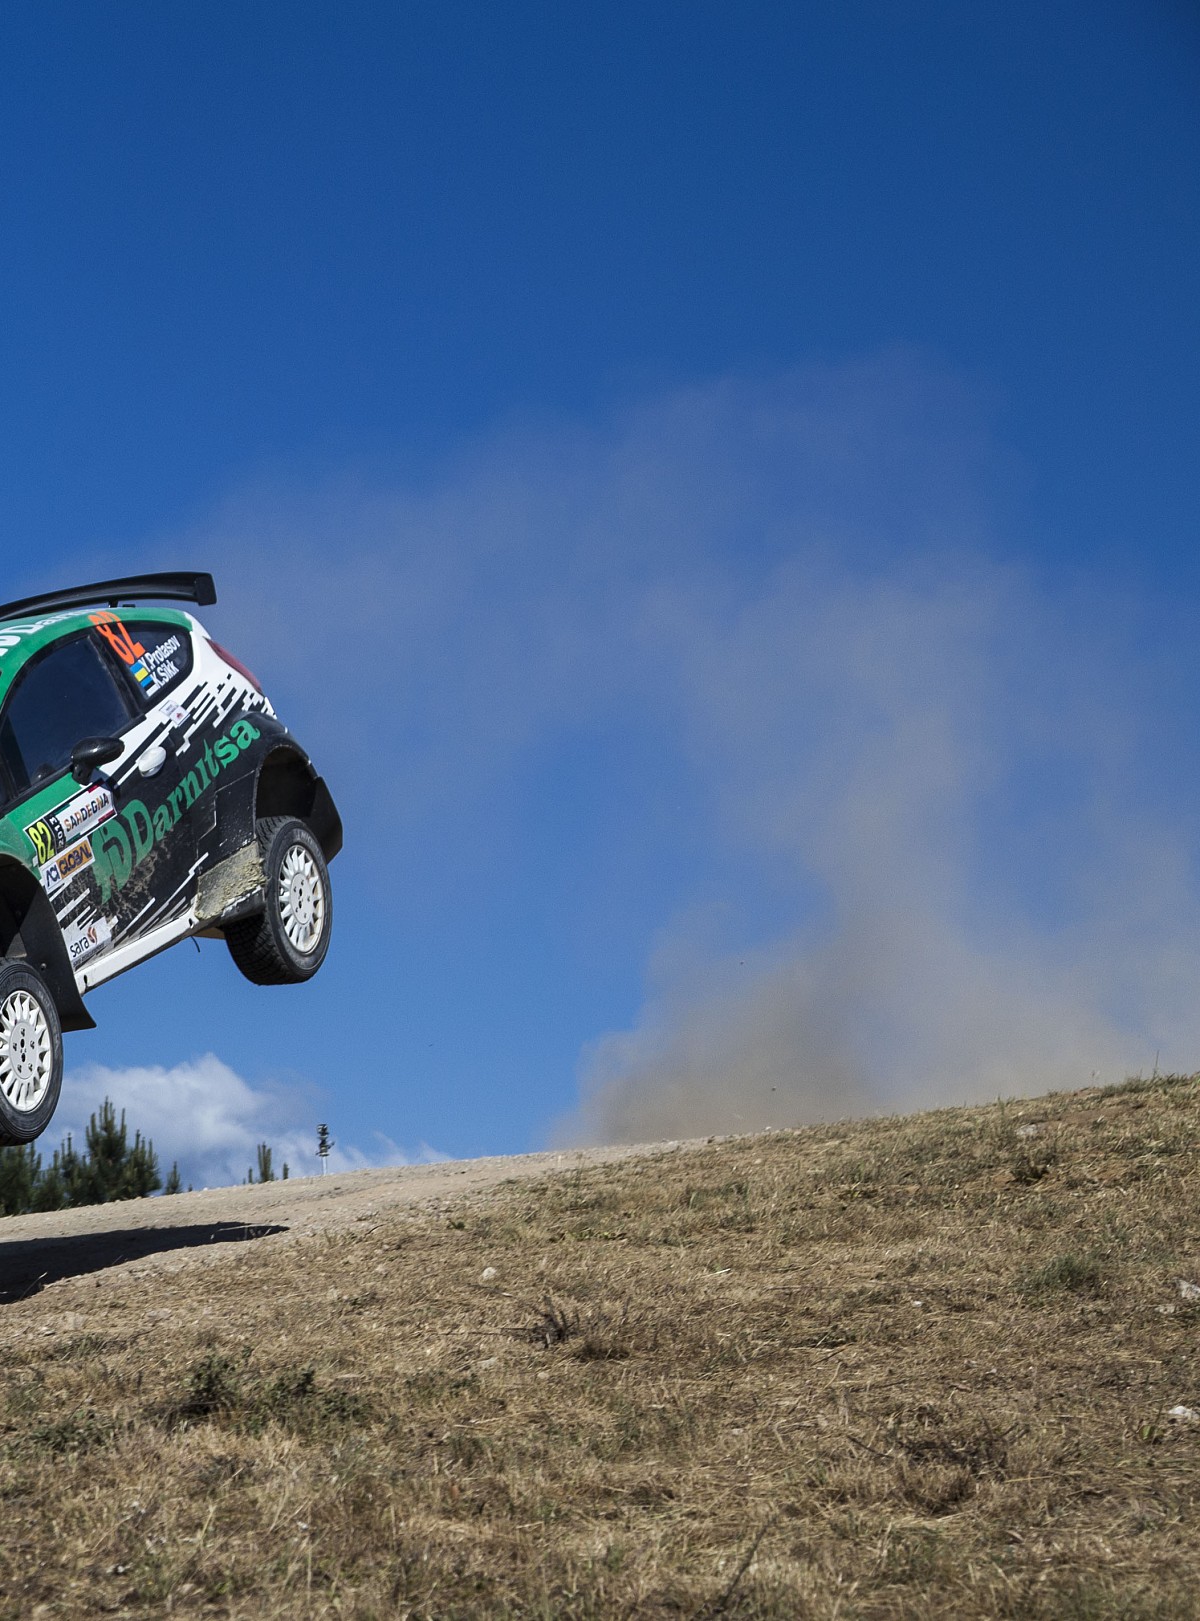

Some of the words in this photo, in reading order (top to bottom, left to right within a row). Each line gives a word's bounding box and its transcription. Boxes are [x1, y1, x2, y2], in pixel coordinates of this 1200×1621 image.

[88, 611, 146, 665] 82
[138, 635, 180, 672] Y.Protasov
[150, 660, 179, 689] K.Sikk
[120, 720, 261, 866] Darnitsa
[49, 816, 64, 847] 2013
[64, 793, 110, 833] SARDEGNA
[28, 821, 54, 864] 82
[58, 844, 93, 876] GLOBAL
[69, 936, 90, 958] sara
